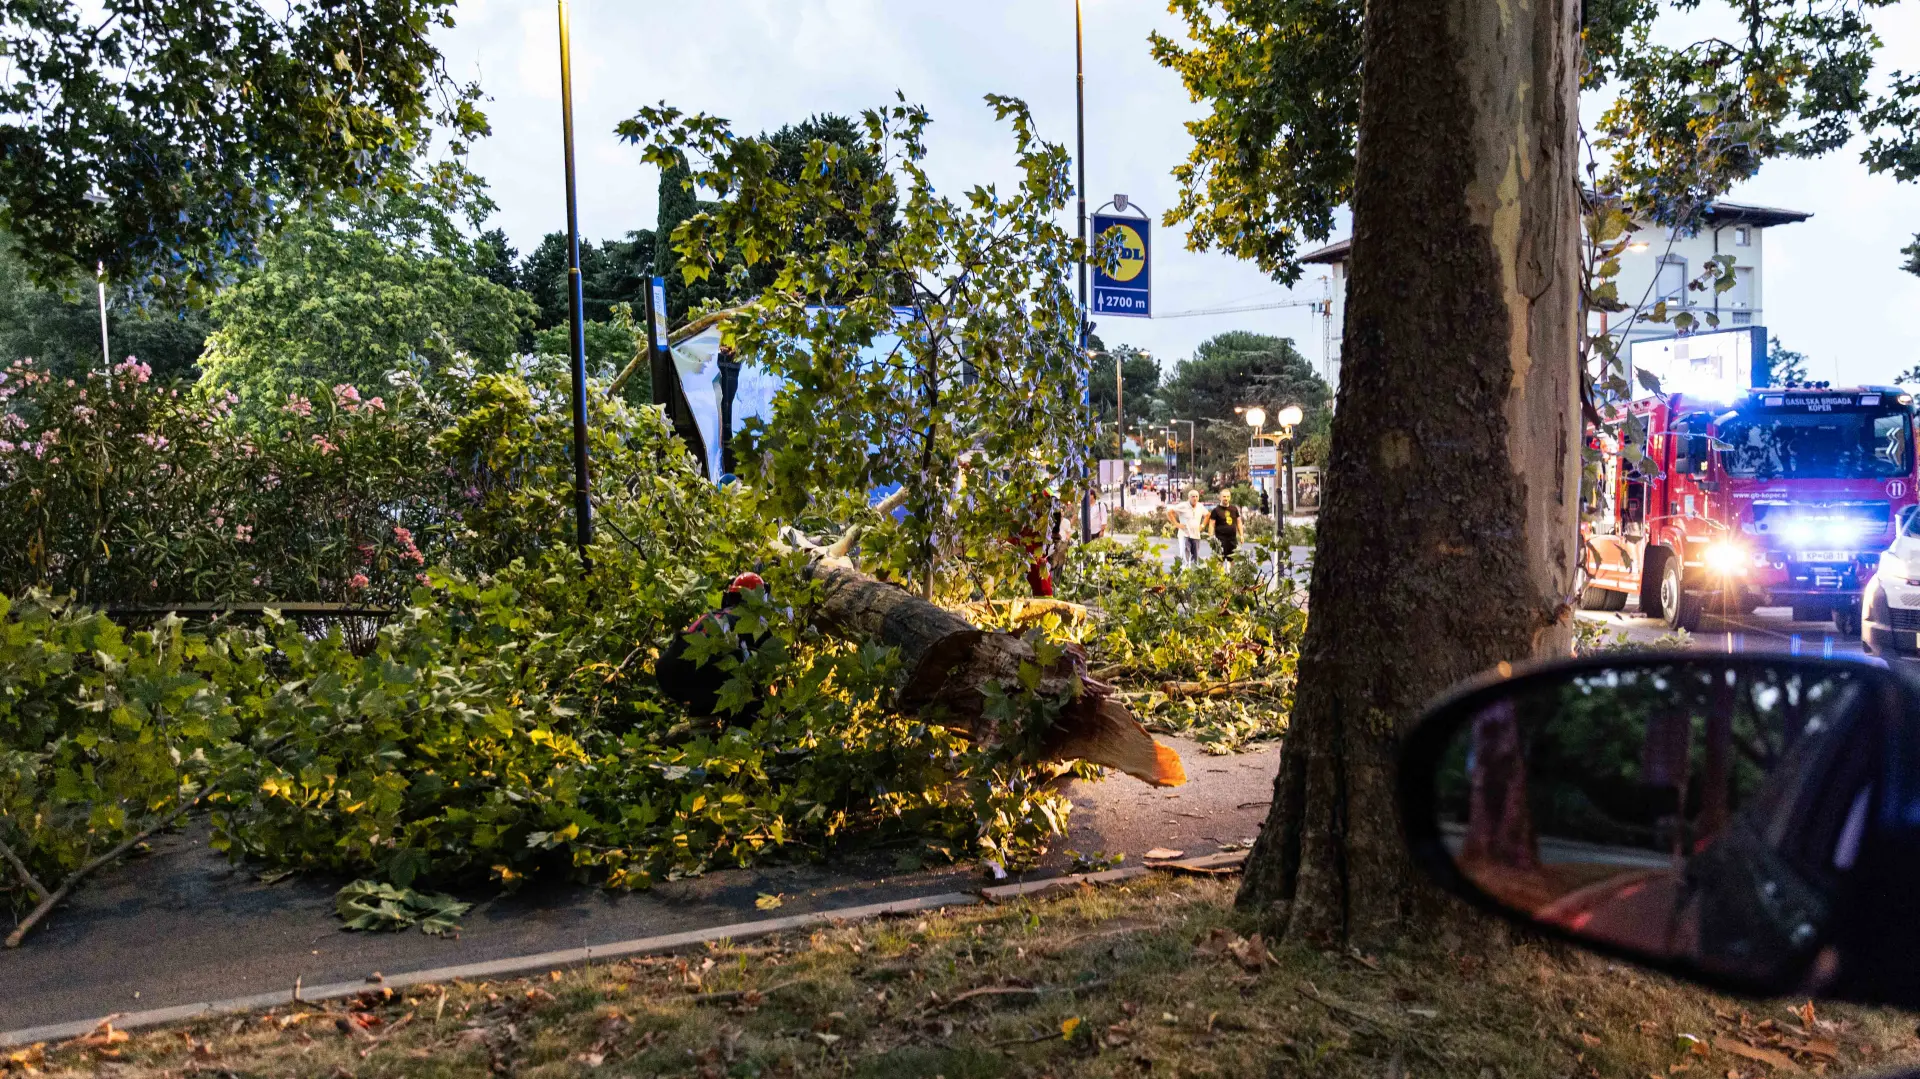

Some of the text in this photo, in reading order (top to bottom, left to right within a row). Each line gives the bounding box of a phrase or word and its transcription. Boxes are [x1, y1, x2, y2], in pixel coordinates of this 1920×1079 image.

[1106, 296, 1146, 308] 2700 m
[1785, 397, 1852, 405] GASILSKA BRIGADA
[1808, 404, 1832, 412] KOPER
[1891, 482, 1902, 496] 11
[1732, 491, 1788, 500] www.gb-koper.si
